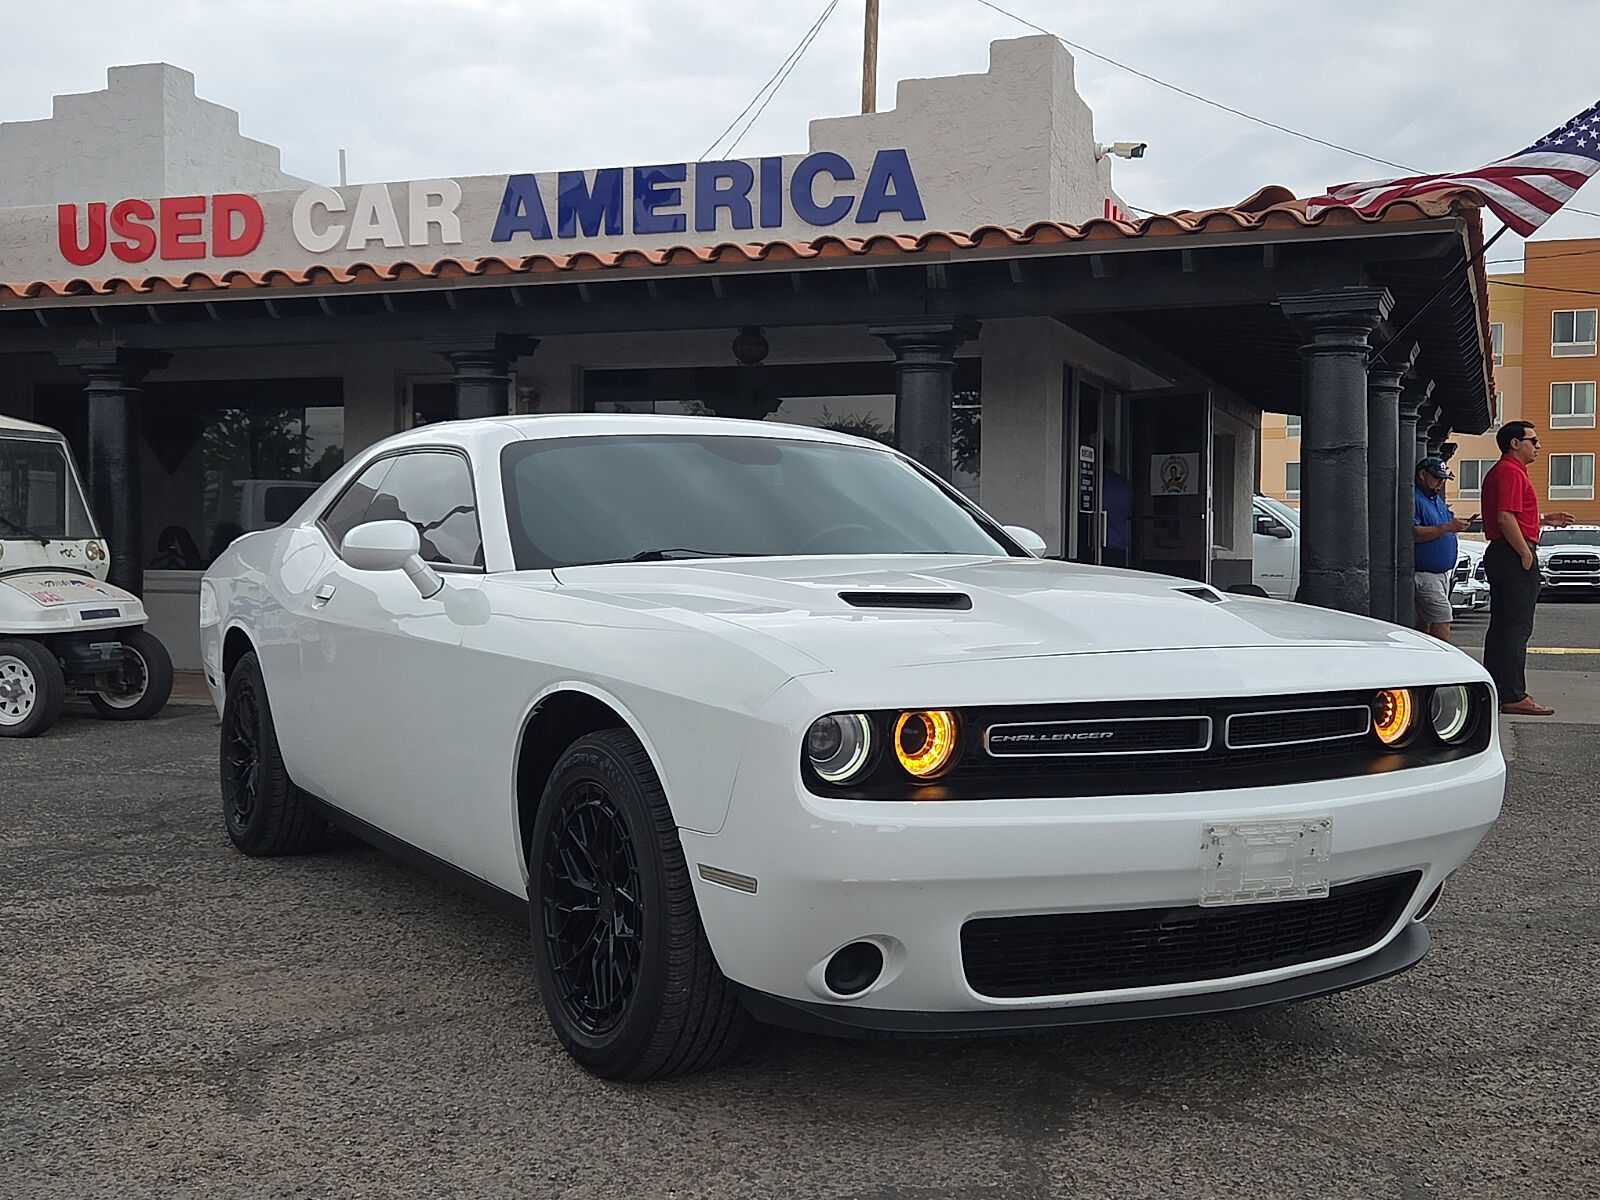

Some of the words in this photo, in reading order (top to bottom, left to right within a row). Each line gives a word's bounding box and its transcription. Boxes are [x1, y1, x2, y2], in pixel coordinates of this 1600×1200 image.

[57, 193, 264, 266] USED
[292, 178, 463, 254] CAR
[491, 148, 927, 243] AMERICA
[990, 732, 1114, 742] CHALLENGER
